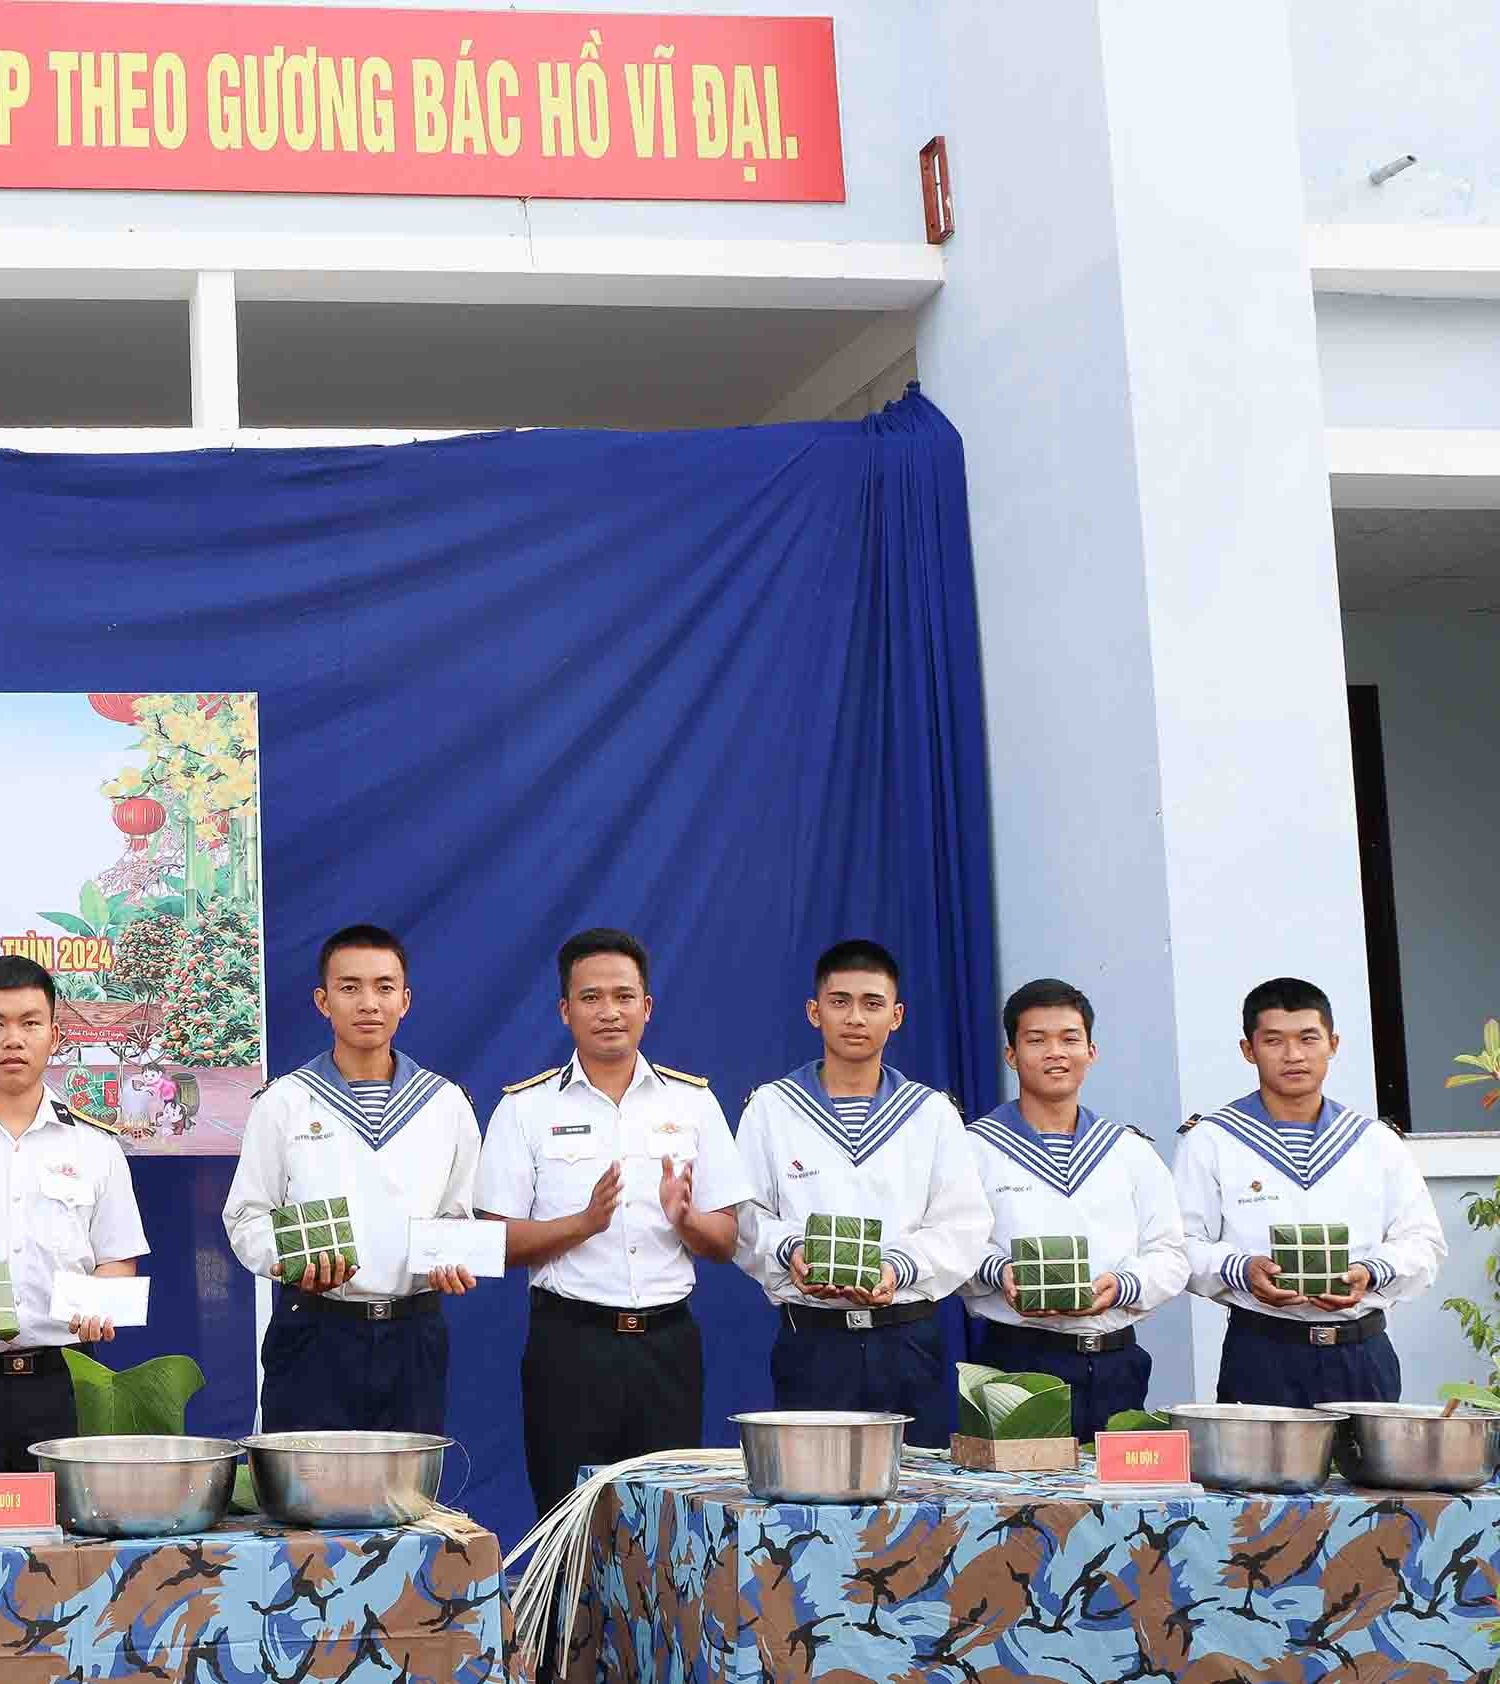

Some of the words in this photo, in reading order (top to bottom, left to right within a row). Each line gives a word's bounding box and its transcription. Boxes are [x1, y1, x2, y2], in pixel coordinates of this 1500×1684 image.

[49, 51, 188, 150] THEO
[207, 46, 396, 154] GƯƠNG
[411, 39, 522, 158] BÁC
[537, 29, 611, 159] HỒ
[624, 44, 678, 159] VĨ
[690, 64, 799, 182] ĐẠI.
[58, 936, 115, 973] 2024
[15, 1493, 21, 1508] 3
